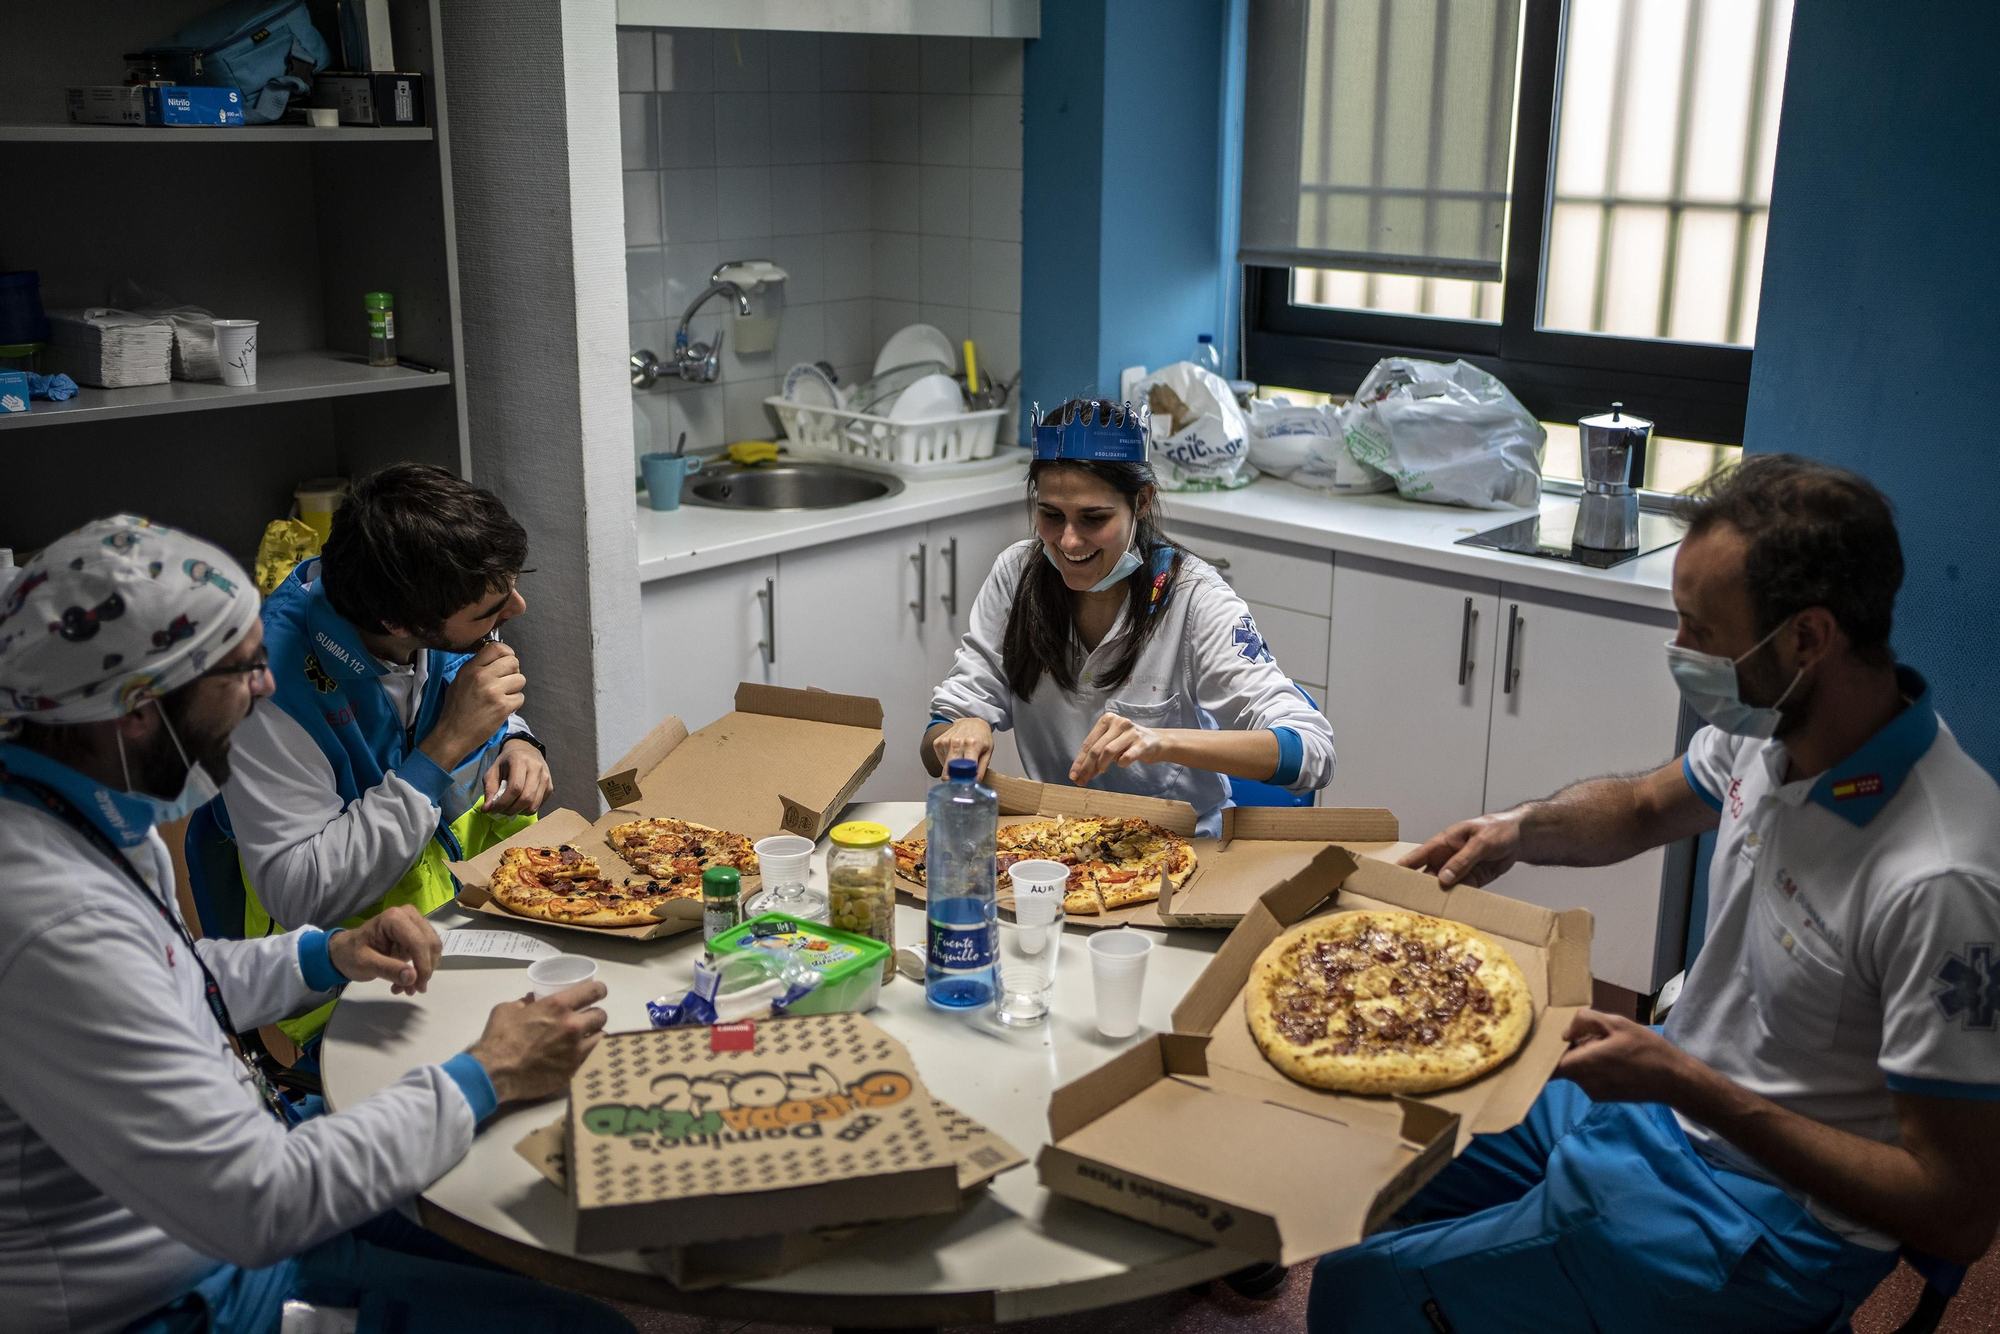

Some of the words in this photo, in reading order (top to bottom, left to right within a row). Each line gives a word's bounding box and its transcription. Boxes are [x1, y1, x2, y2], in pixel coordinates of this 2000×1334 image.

[167, 98, 190, 107] Nitrilo
[229, 92, 238, 103] S
[315, 632, 350, 664] SUMMA
[349, 659, 365, 675] 112
[1030, 884, 1055, 893] ANA
[934, 931, 974, 948] Fuente
[932, 943, 979, 964] Arquillo
[650, 1063, 853, 1117] ROLL
[630, 1122, 824, 1155] Domino's
